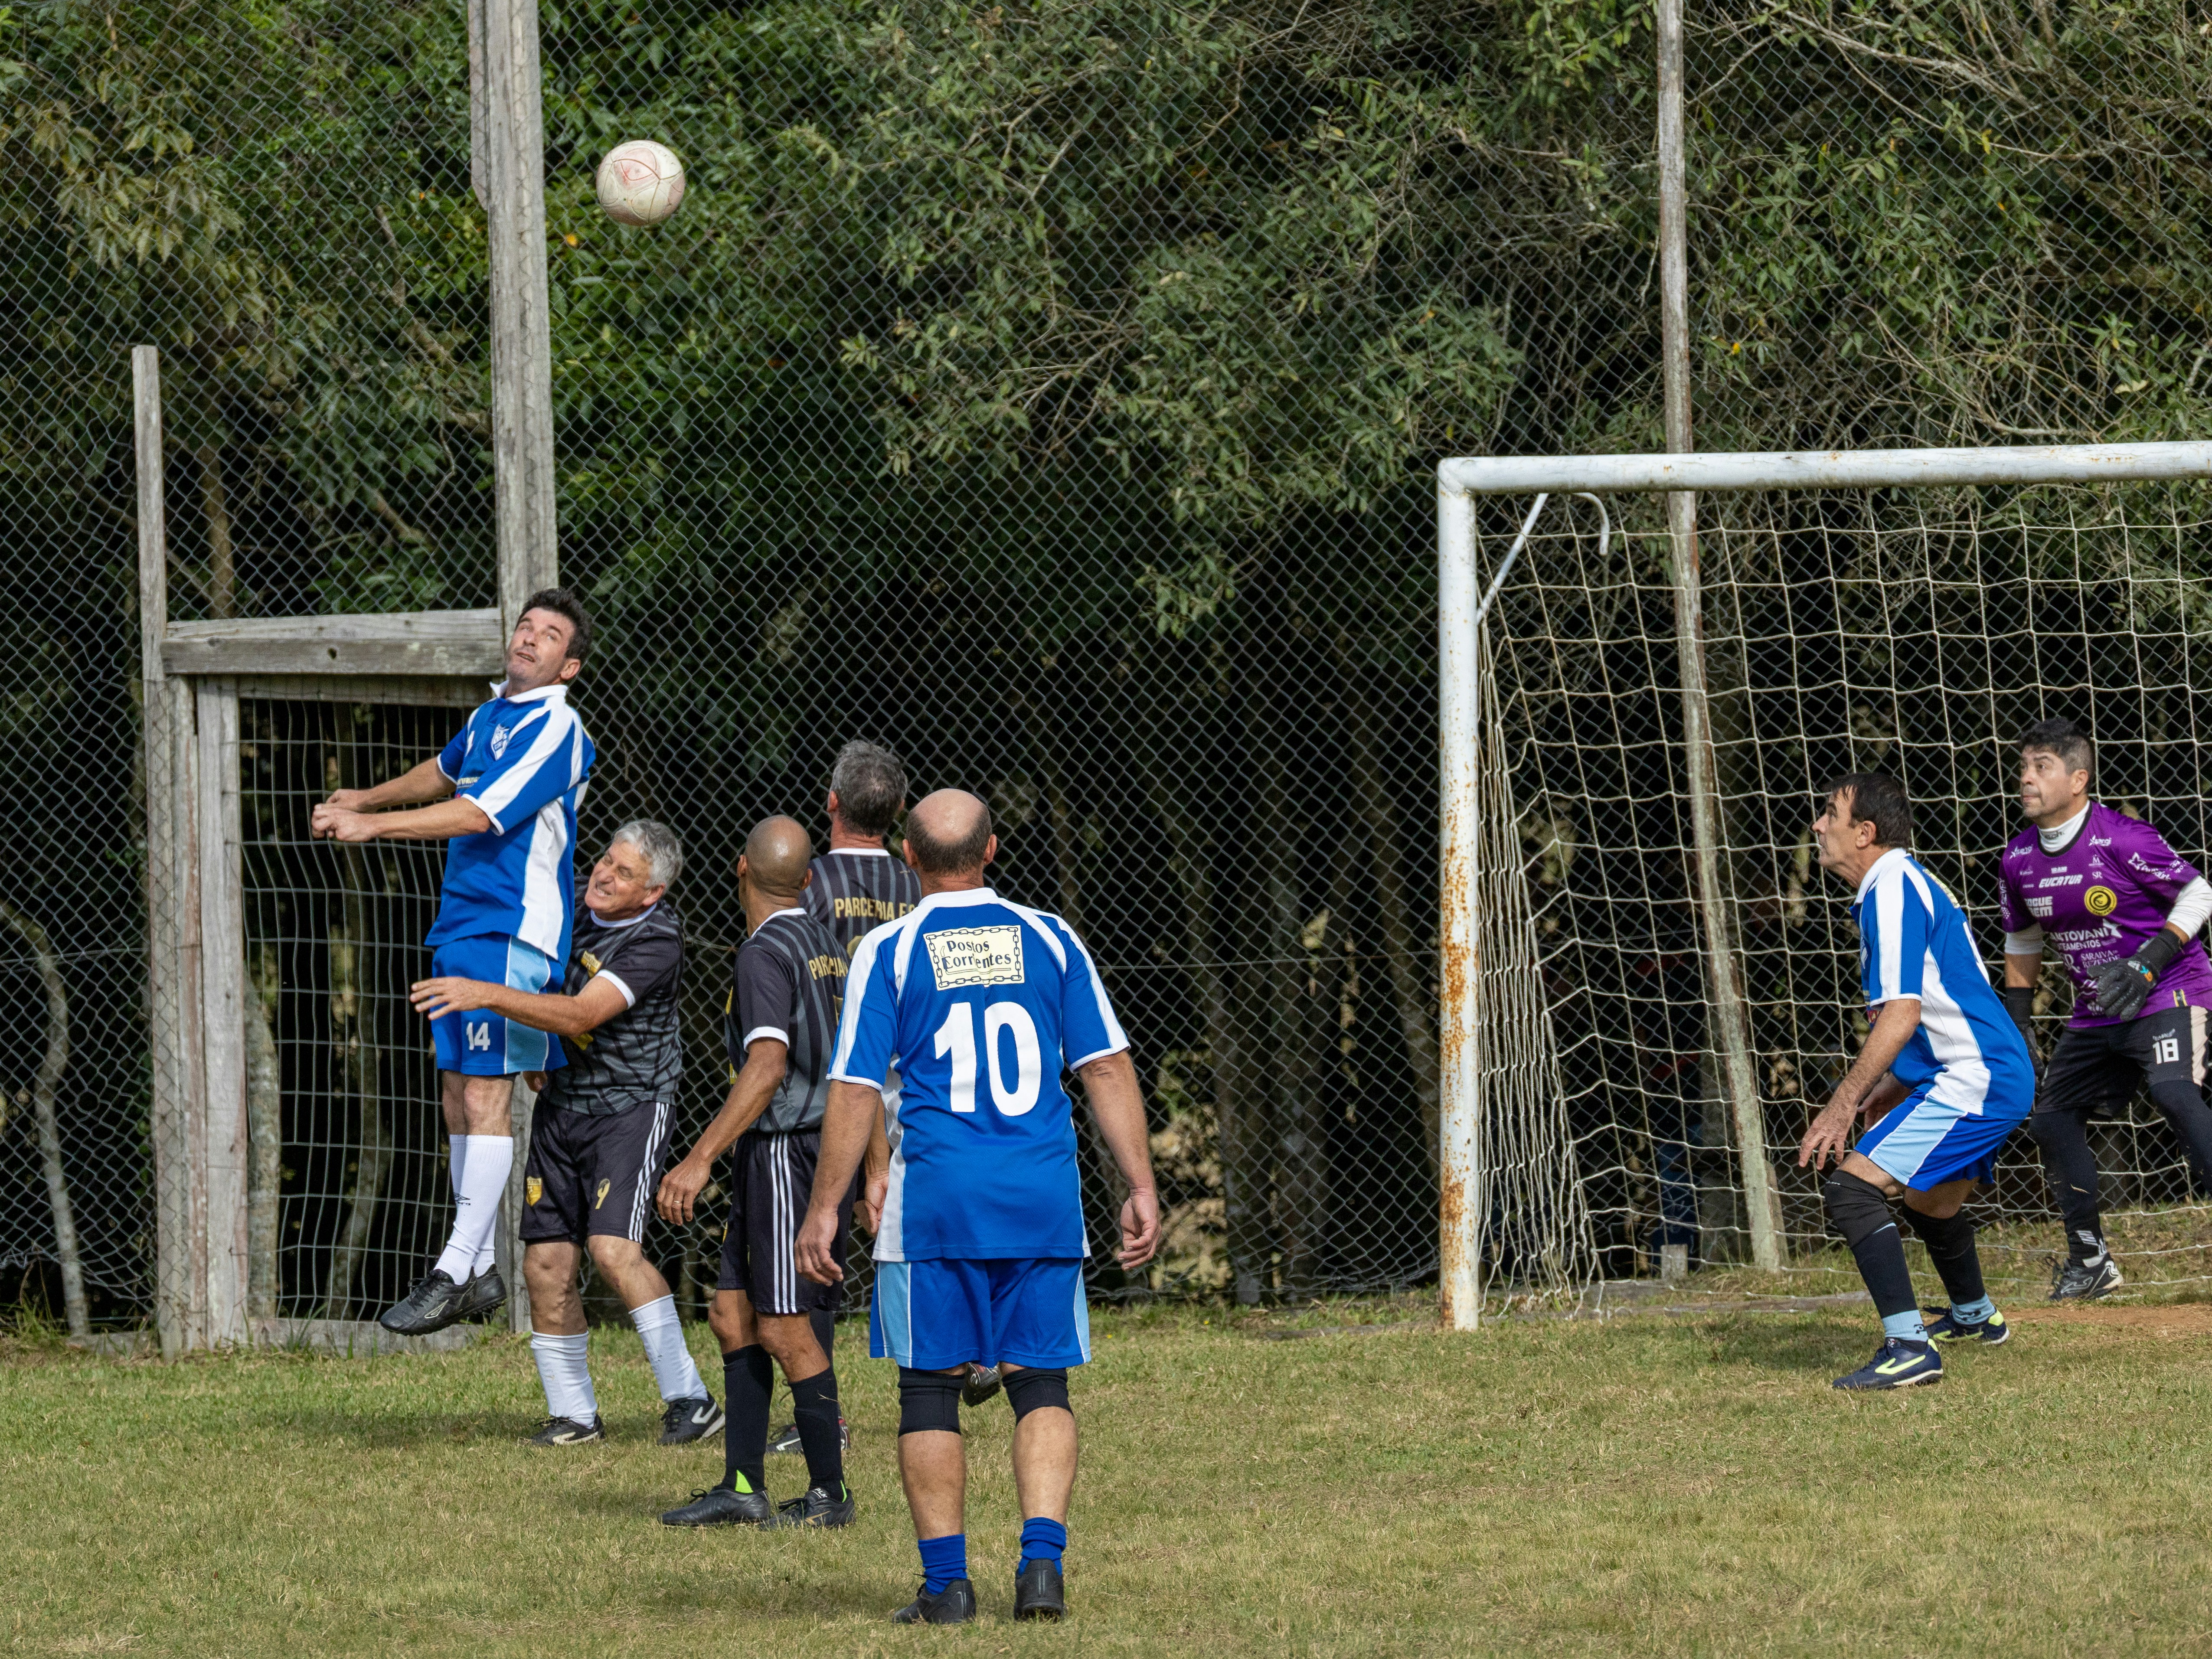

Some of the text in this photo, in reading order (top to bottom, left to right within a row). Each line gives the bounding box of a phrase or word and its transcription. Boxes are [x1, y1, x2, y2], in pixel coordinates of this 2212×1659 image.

[2039, 874, 2083, 888] EUCATUR
[834, 897, 895, 921] PARCERIA
[2024, 896, 2053, 907] OGUE
[2049, 927, 2110, 941] ANTOVANI
[946, 941, 990, 953] Postos
[2081, 950, 2114, 961] SARAIVA
[466, 1022, 490, 1051] 14
[934, 1002, 1041, 1116] 10
[2152, 1038, 2179, 1065] 18
[595, 1179, 611, 1209] 9
